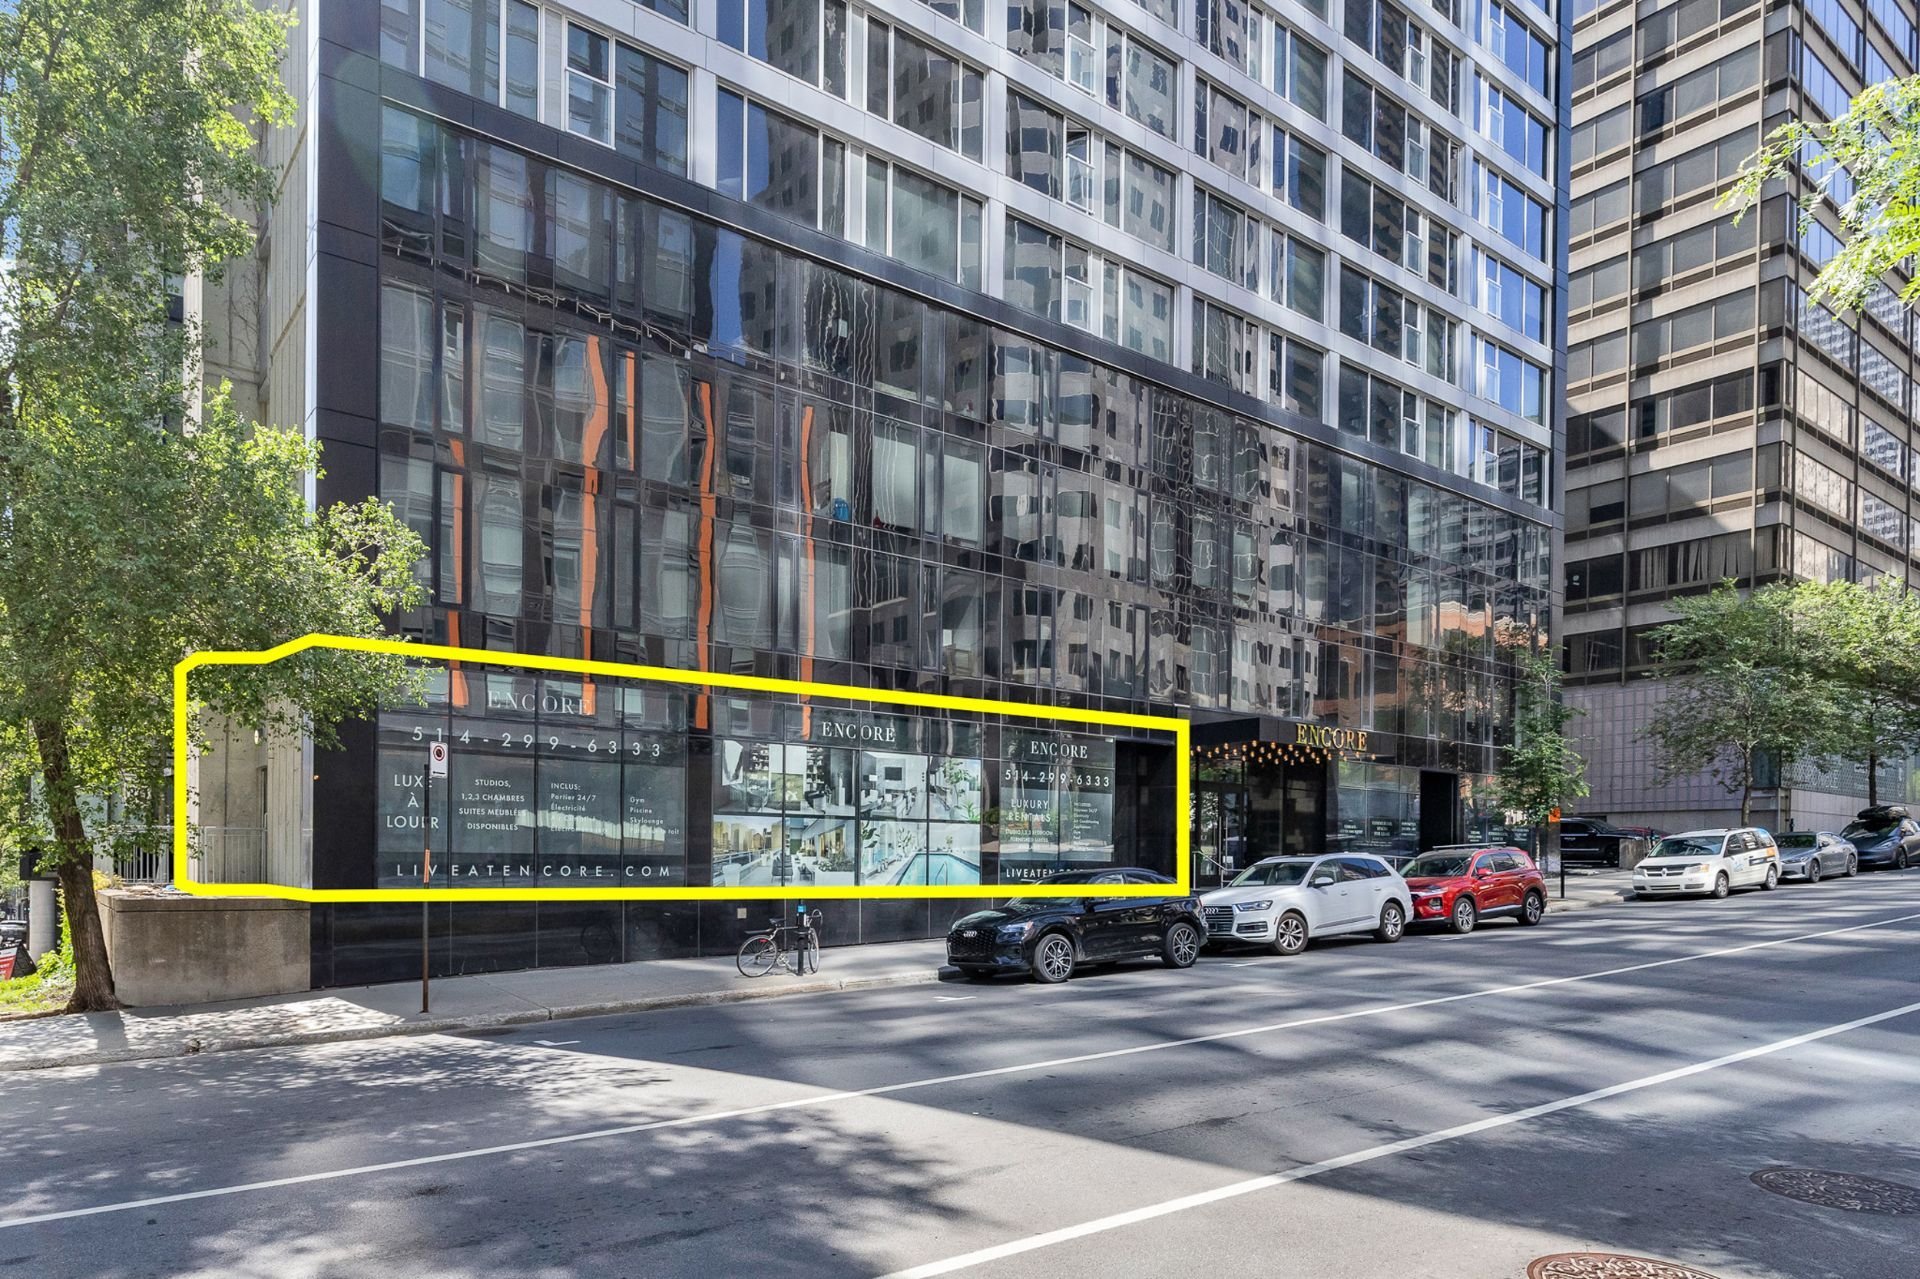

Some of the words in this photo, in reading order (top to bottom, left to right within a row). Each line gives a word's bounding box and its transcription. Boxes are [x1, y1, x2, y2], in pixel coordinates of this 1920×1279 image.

[488, 691, 594, 716] ENCORE
[822, 721, 896, 742] ENCORE
[1296, 722, 1368, 752] ENCORE
[412, 726, 661, 757] 514-299-6333
[1031, 740, 1088, 759] ENCORE
[474, 779, 511, 788] STUDIOS,
[1005, 769, 1110, 787] 514-299-6333
[550, 783, 581, 791] INCLUS:
[407, 792, 419, 808] À
[482, 794, 525, 802] CHAMBRES
[577, 794, 597, 802] 24/7
[1011, 799, 1049, 809] LUXURY
[458, 808, 486, 816] SUITES
[1008, 811, 1051, 823] RENTALS
[467, 823, 519, 831] DISPONIBLES
